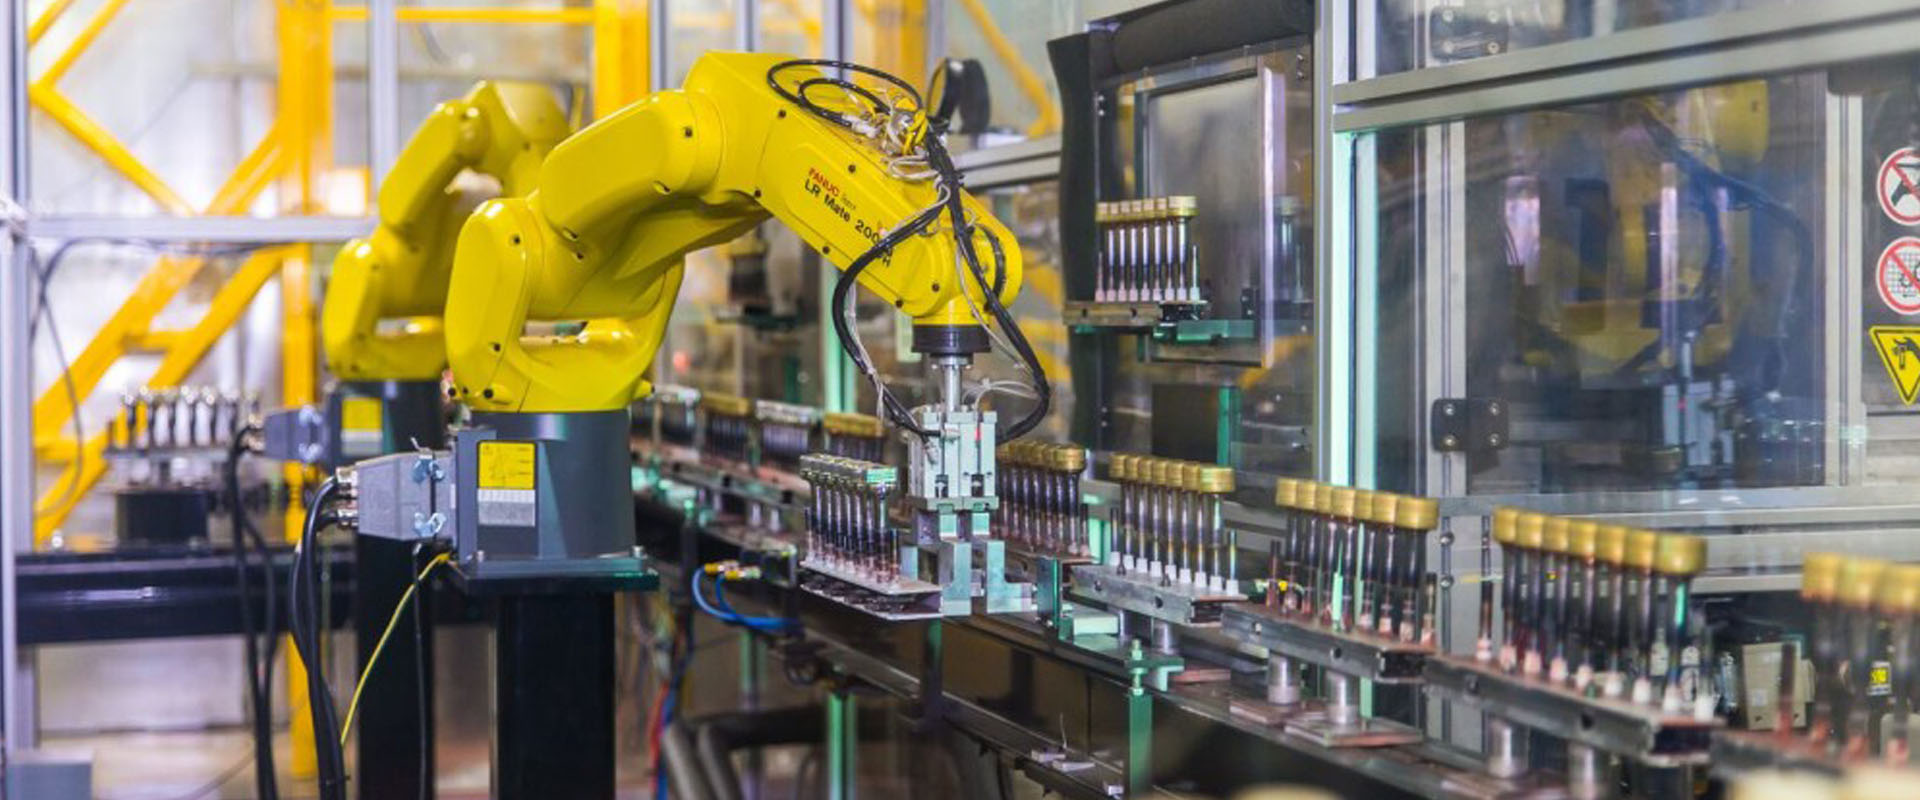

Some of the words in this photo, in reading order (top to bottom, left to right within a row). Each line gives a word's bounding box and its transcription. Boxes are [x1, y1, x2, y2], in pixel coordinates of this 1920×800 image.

[805, 179, 821, 197] LR
[824, 193, 850, 222] Mate
[809, 168, 840, 197] FANUC
